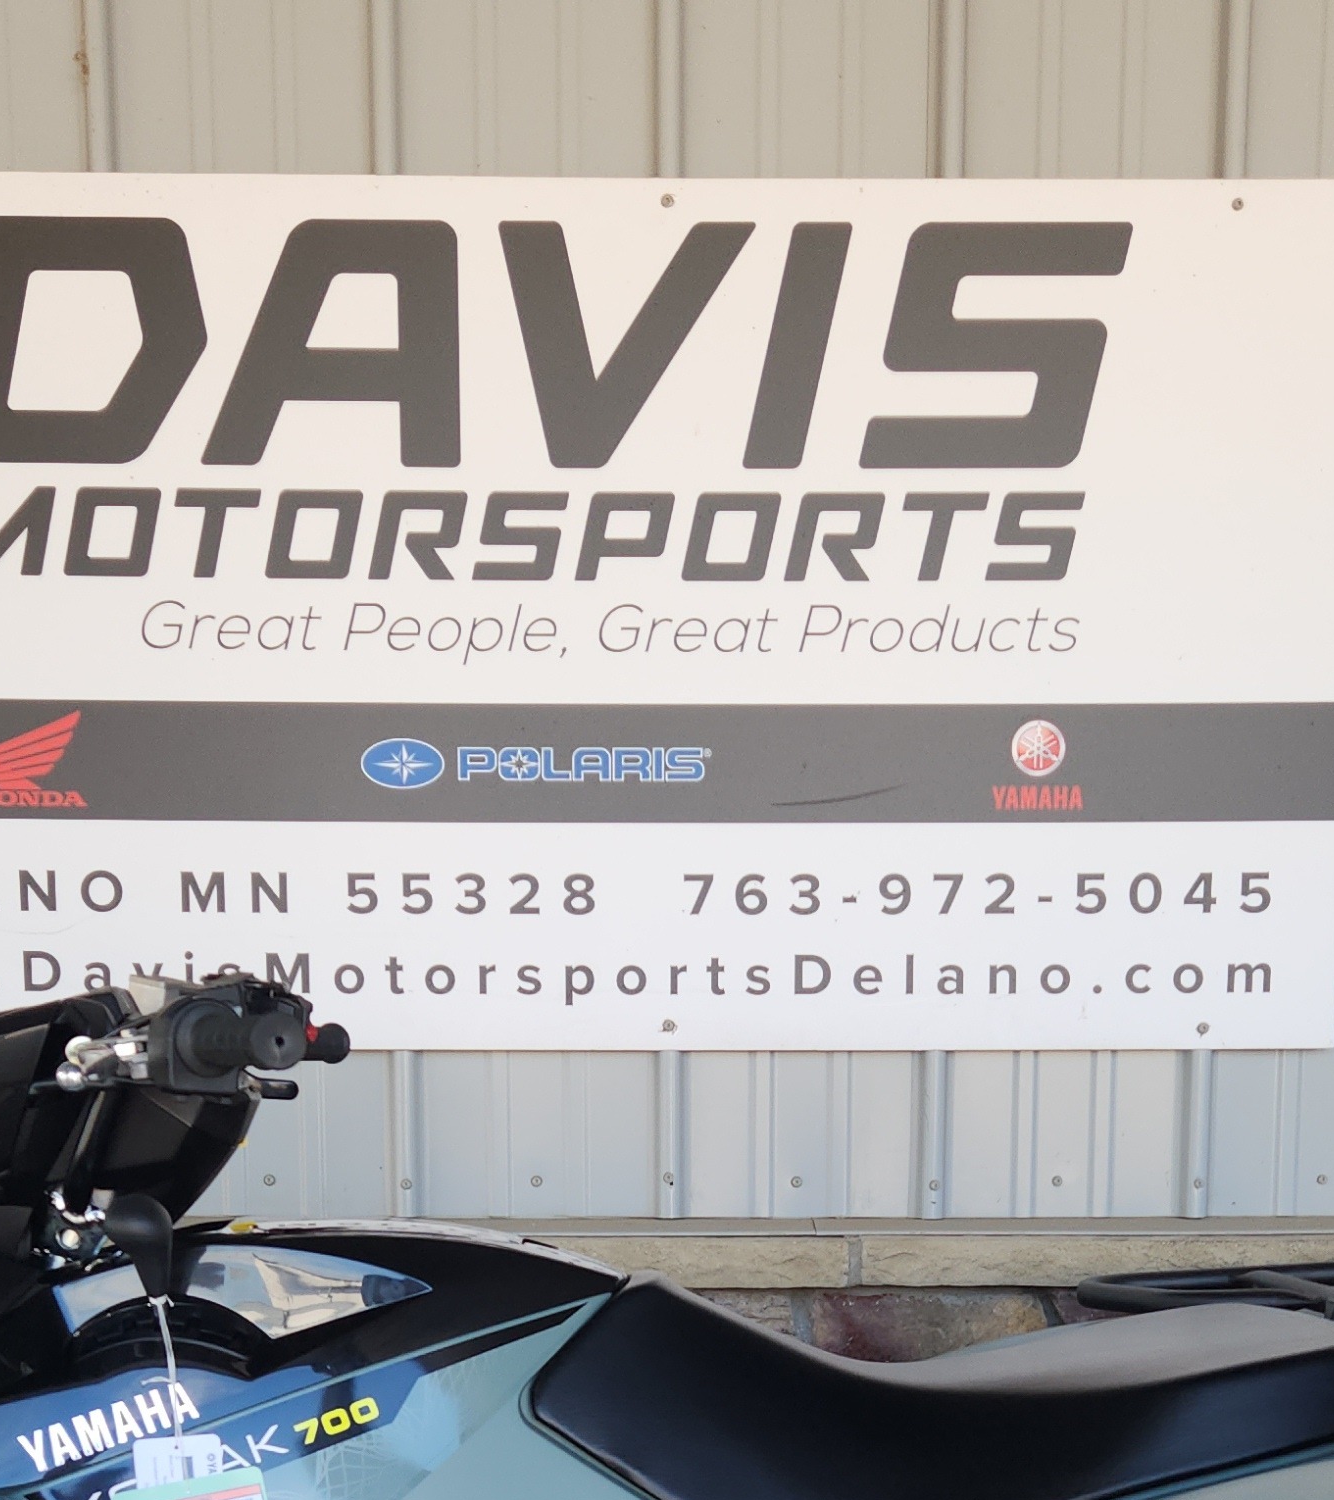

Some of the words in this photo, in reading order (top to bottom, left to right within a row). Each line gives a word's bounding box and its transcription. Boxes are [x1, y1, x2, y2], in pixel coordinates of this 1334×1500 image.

[141, 599, 323, 652] Great
[343, 602, 567, 667] People,
[598, 603, 779, 654] Great
[798, 603, 1080, 654] Products
[457, 746, 704, 783] POLARIS
[992, 785, 1083, 811] YAMAHA
[180, 871, 289, 915] MN
[347, 872, 598, 917] 55328
[683, 872, 1272, 917] 763-972-5045
[17, 1382, 201, 1474] YAMAHA
[293, 1397, 380, 1446] 700
